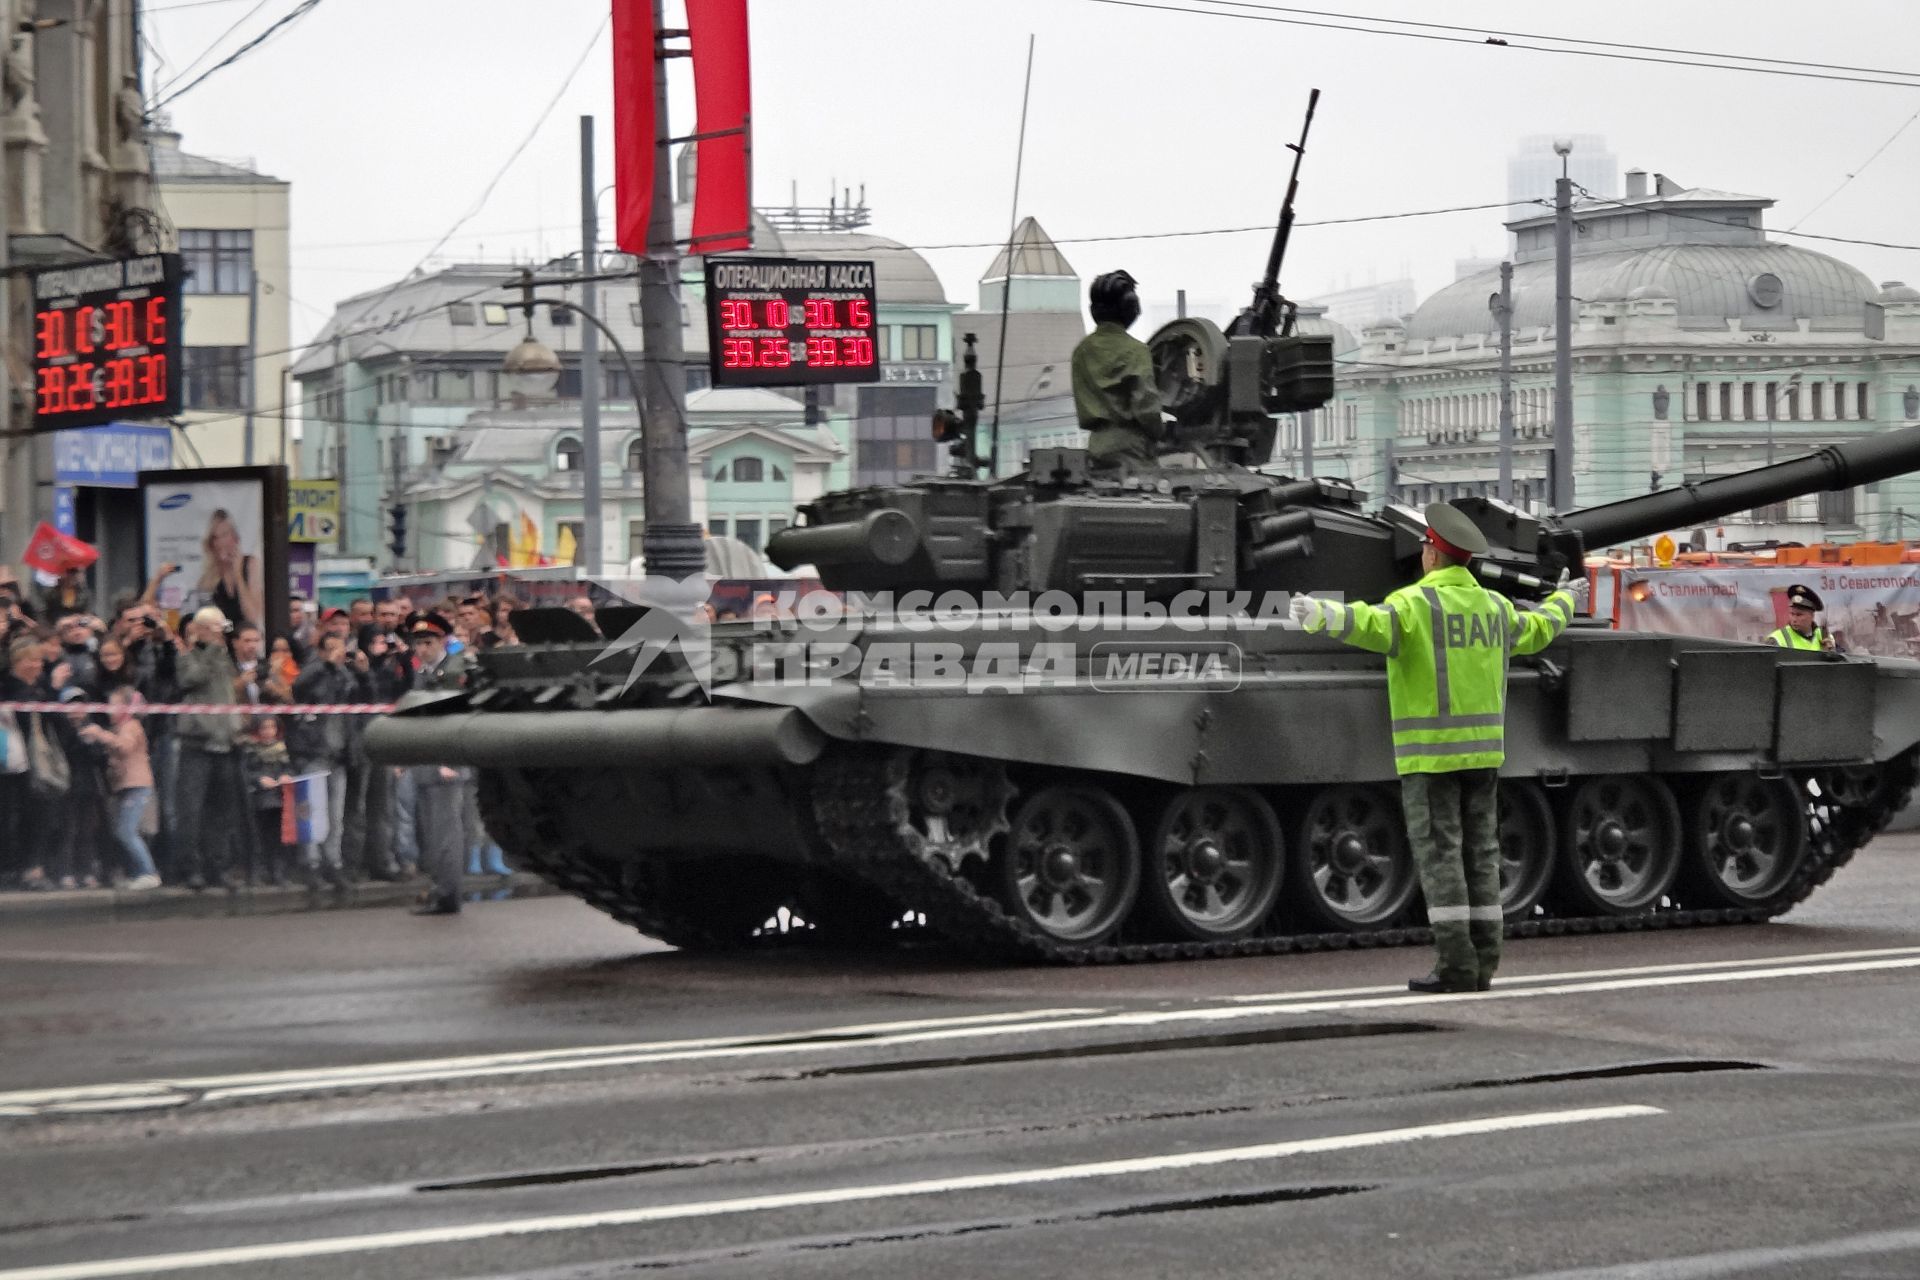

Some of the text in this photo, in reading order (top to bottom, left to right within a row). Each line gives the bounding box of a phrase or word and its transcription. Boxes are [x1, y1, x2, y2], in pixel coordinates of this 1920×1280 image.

[714, 264, 873, 291] ОПЕРАЦИОННАЯ КАССА
[722, 337, 791, 368] 39.25
[806, 337, 873, 367] 39.30
[1659, 581, 1739, 597] Сталинград!
[1820, 575, 1836, 591] За
[1447, 613, 1502, 649] ВАИ
